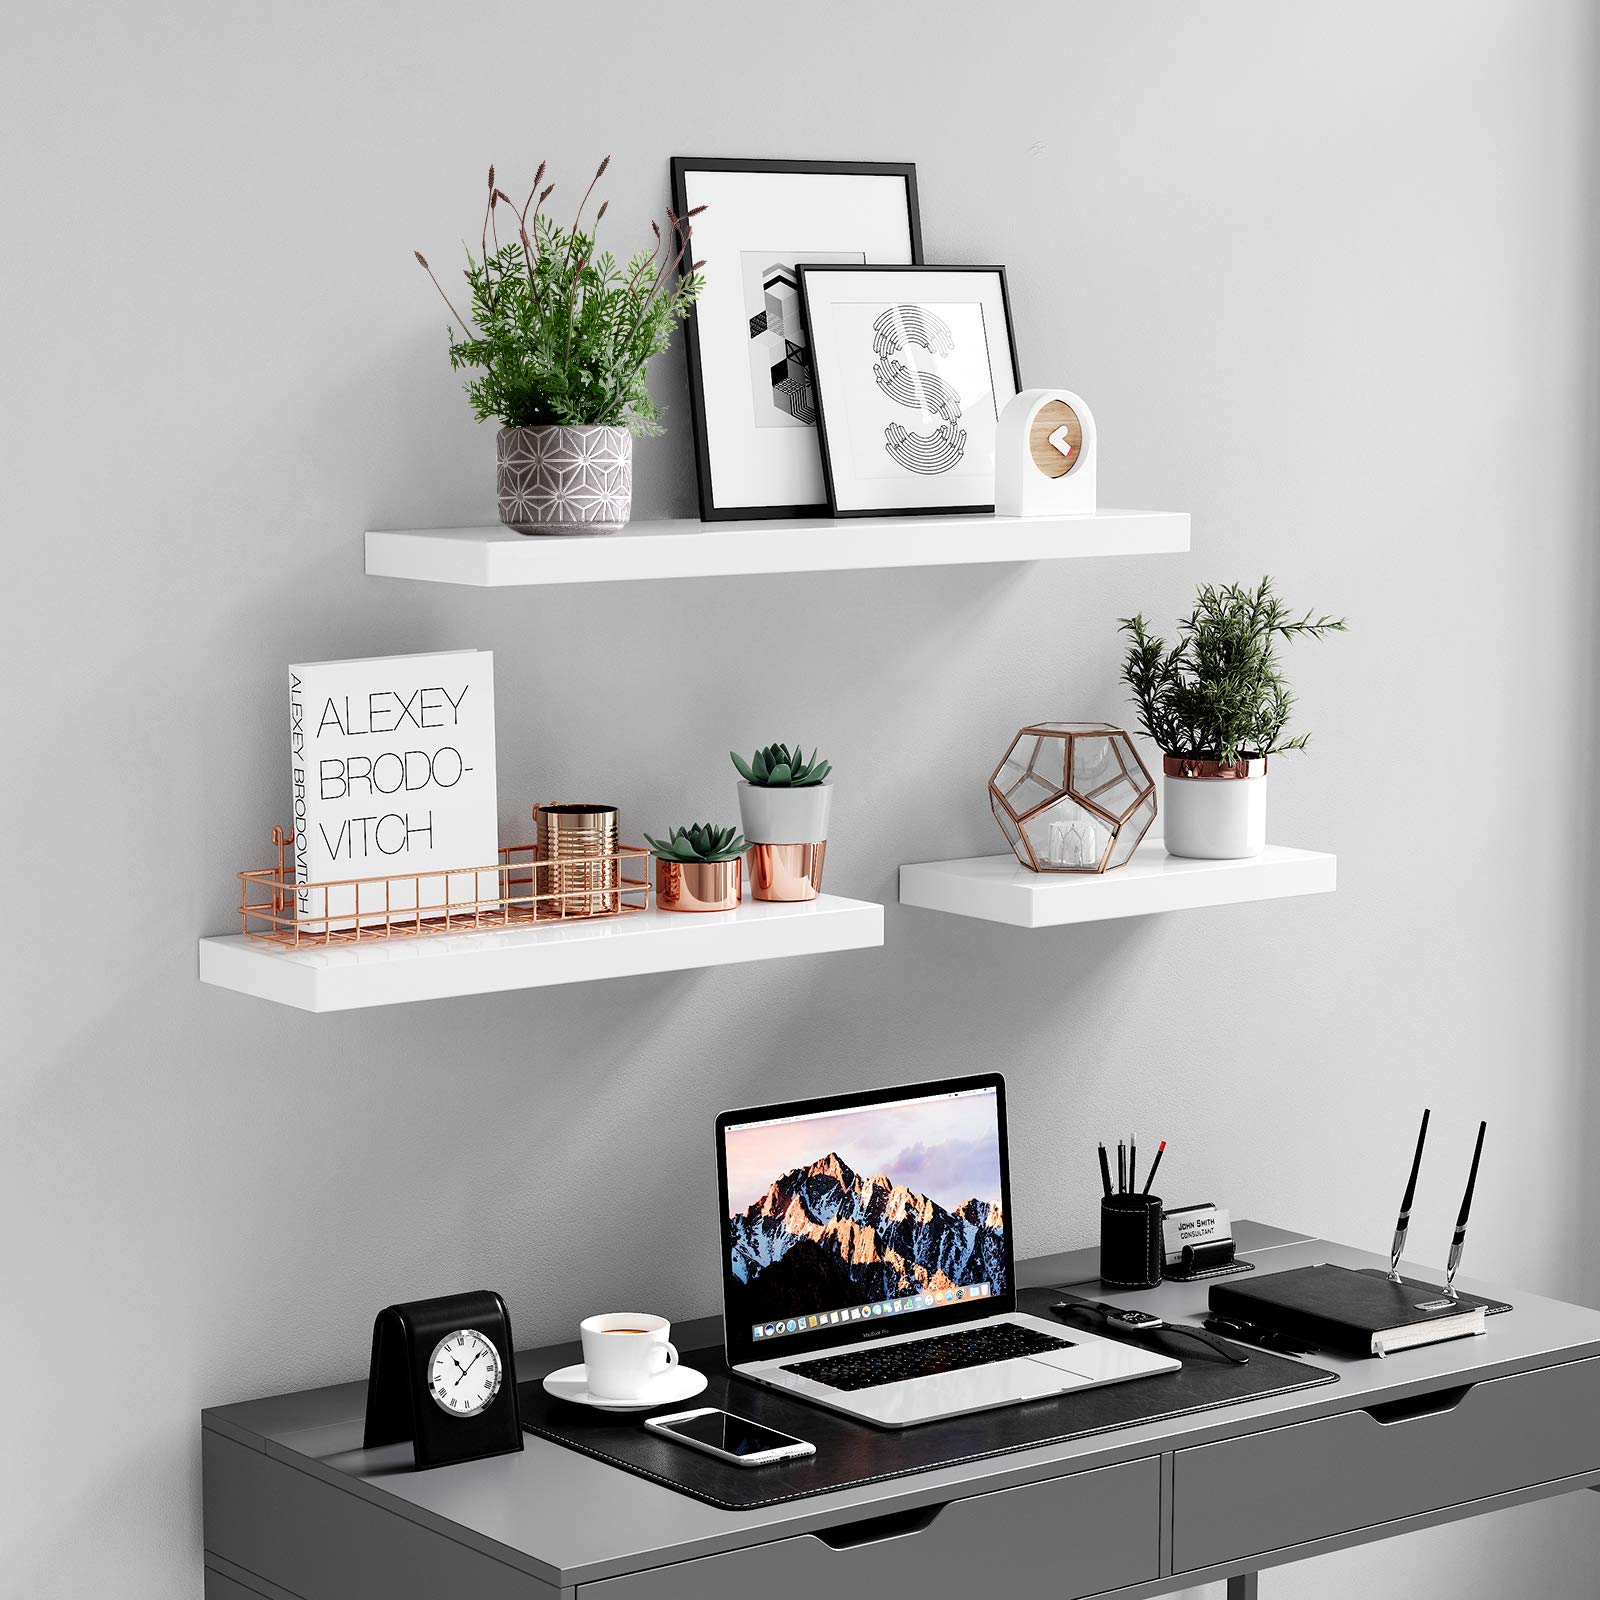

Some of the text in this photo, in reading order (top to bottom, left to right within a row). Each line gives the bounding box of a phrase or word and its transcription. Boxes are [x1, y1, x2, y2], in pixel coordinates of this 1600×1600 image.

[317, 685, 469, 738] ALEXEY
[291, 672, 309, 914] ALEXEY BRODOVITCH
[320, 747, 473, 800] BRODO-
[319, 810, 433, 860] VITCH
[1180, 1227, 1214, 1240] CONSULTANT
